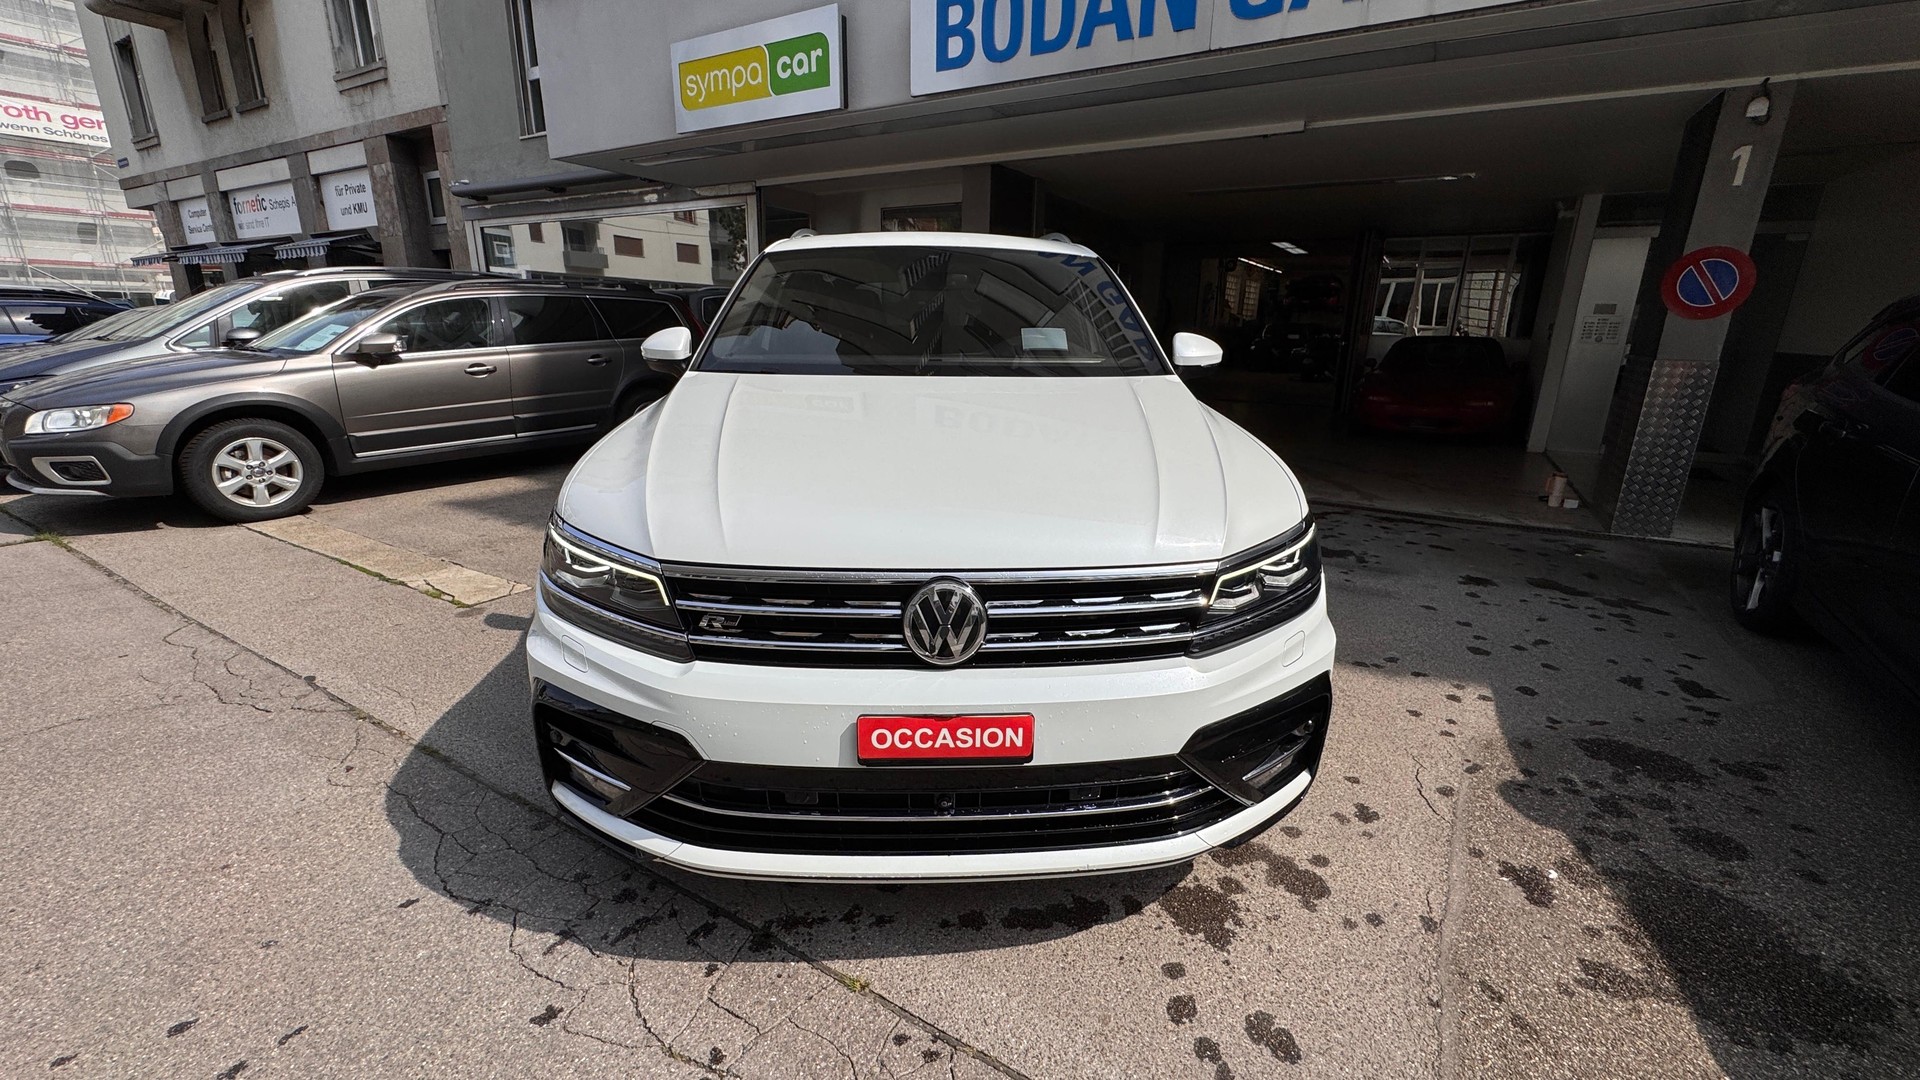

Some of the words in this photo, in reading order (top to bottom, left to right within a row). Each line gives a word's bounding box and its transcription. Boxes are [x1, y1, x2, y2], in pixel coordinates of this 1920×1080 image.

[936, 0, 1196, 72] BODAN
[685, 62, 762, 102] sympa
[776, 47, 823, 79] car
[42, 127, 108, 143] Schönes
[1731, 145, 1753, 186] 1
[344, 183, 367, 195] Private
[341, 204, 353, 216] und
[352, 202, 368, 215] KMU
[871, 727, 1024, 749] OCCASION
